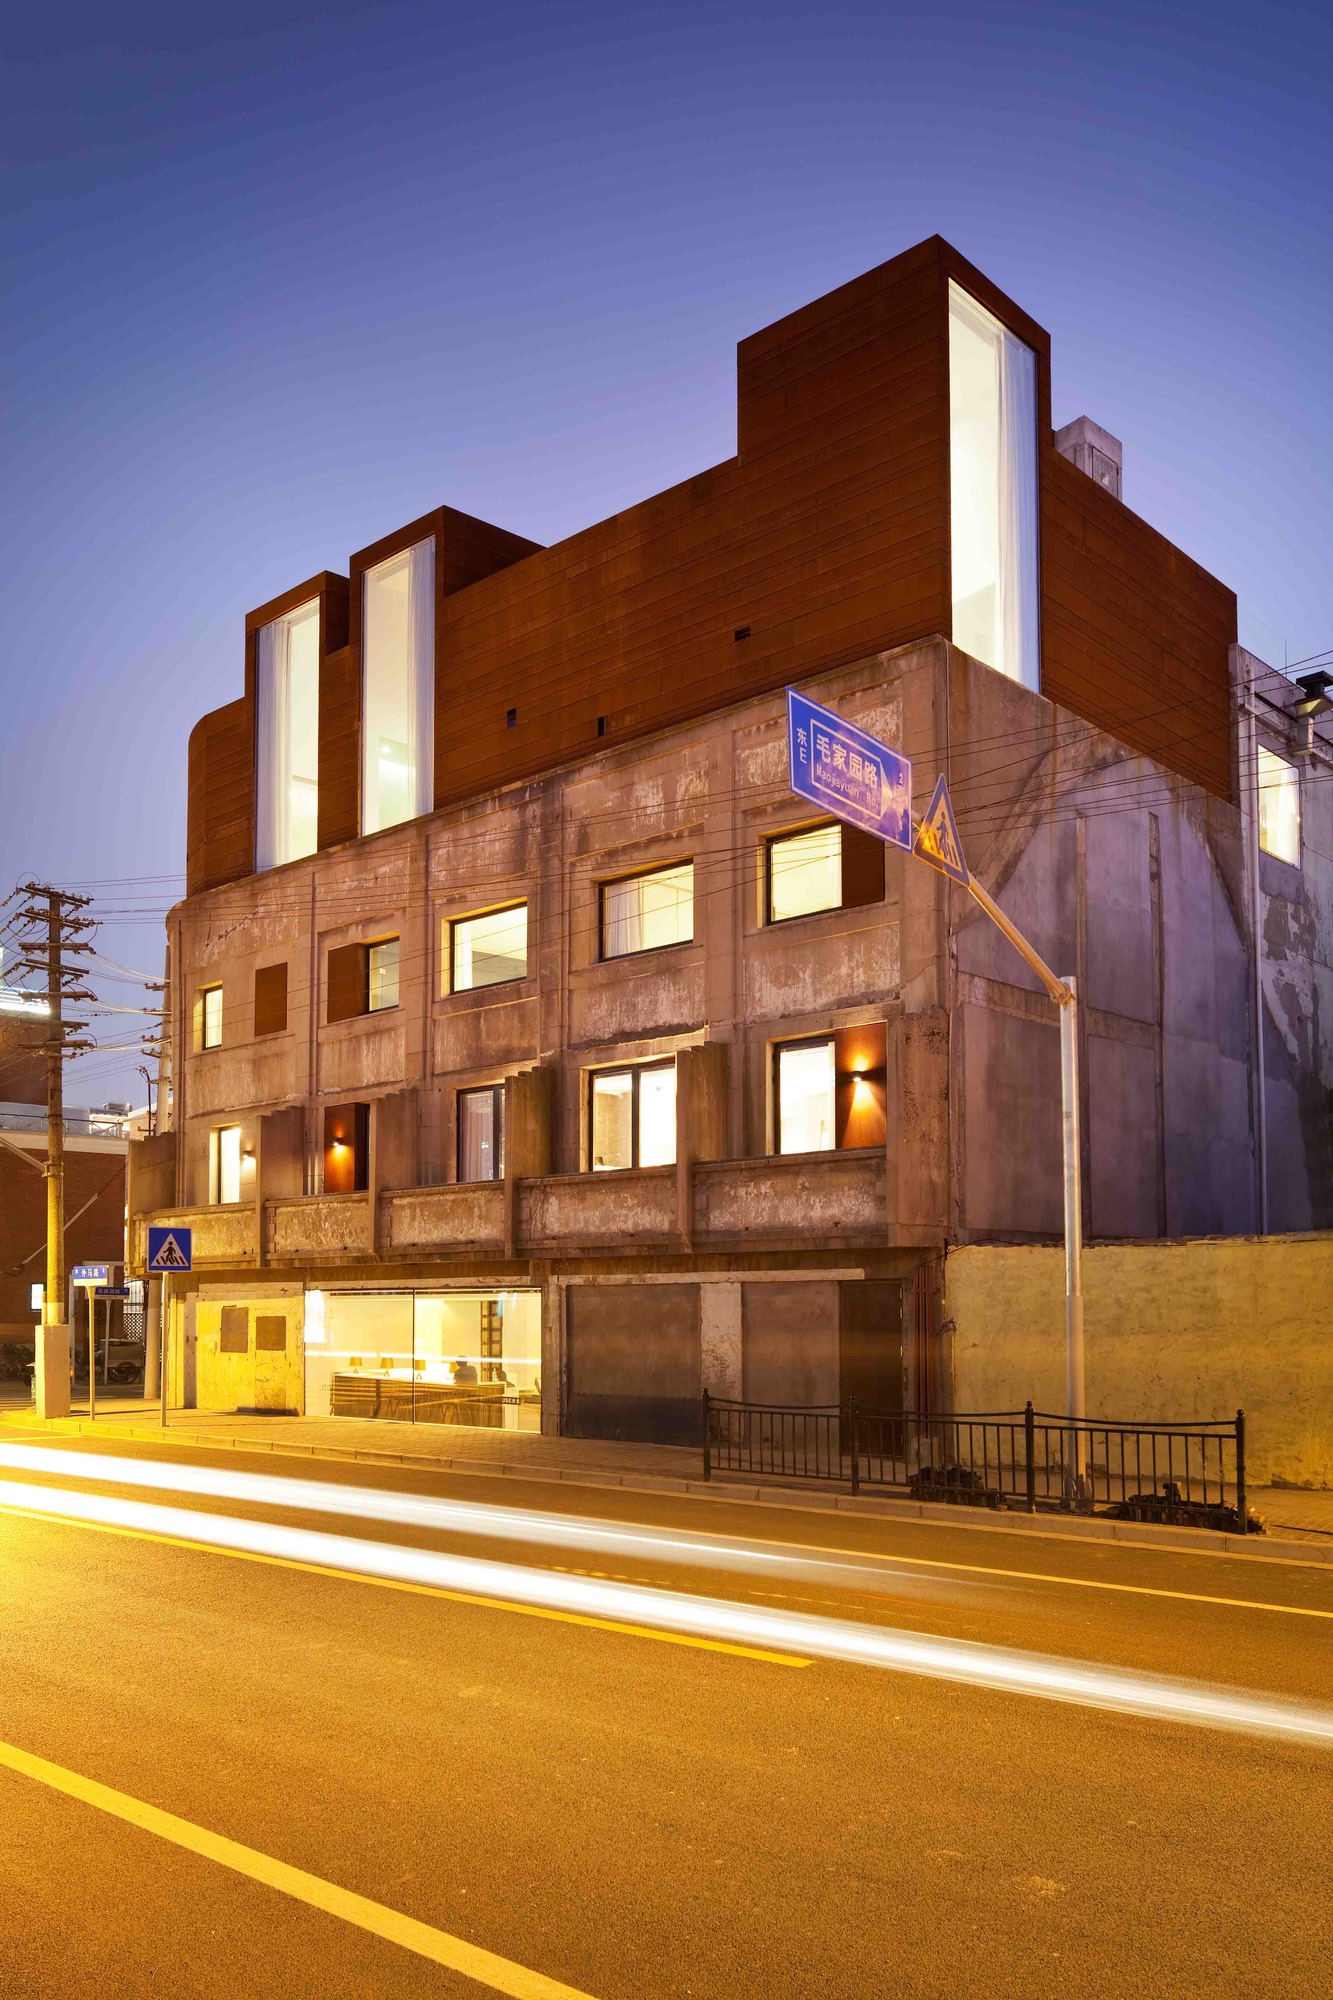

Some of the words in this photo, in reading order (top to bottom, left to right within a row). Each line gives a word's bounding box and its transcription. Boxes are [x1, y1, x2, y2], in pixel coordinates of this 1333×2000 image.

[797, 728, 807, 746] 东
[800, 747, 807, 764] E
[816, 734, 878, 790] 毛家园路
[817, 763, 859, 798] Maojiayuan
